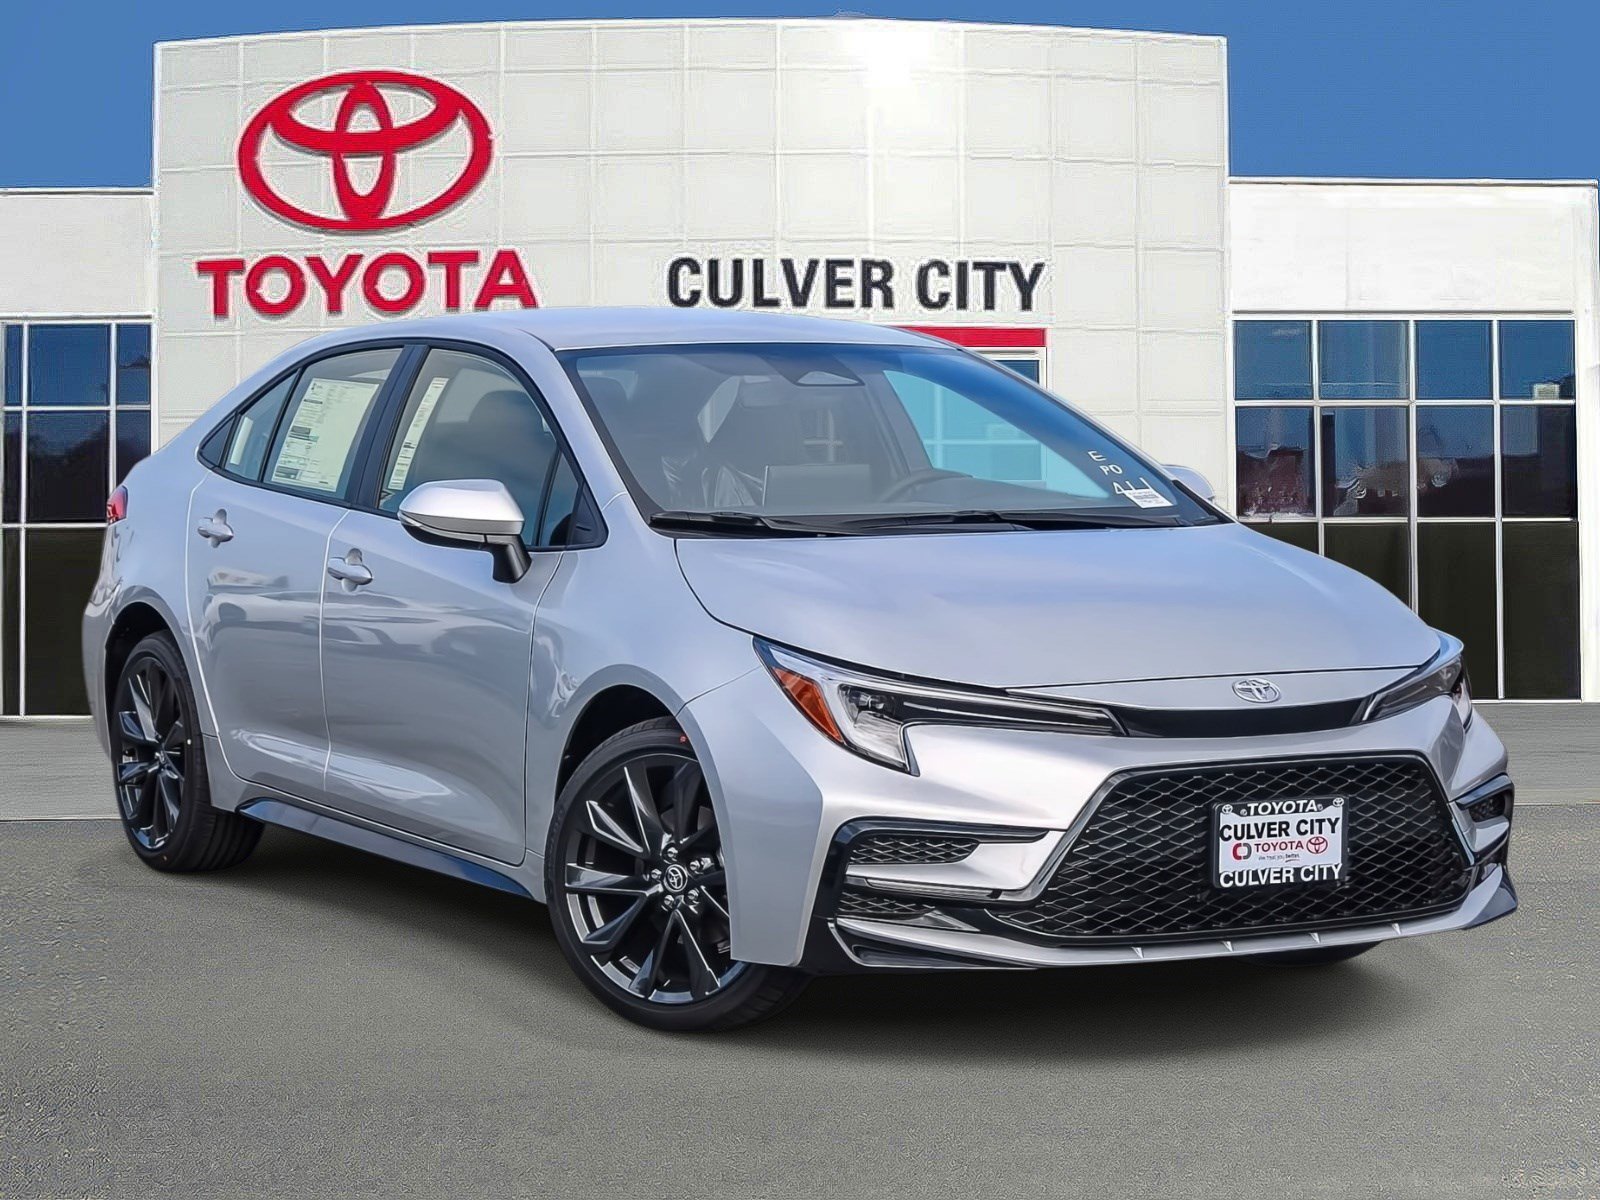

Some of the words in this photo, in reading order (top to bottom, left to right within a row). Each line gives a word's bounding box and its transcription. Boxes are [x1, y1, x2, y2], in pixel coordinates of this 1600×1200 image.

[196, 249, 539, 318] TOYOTA
[667, 257, 895, 308] CULVER
[916, 258, 1046, 311] CITY
[1247, 799, 1318, 816] TOYOTA
[1219, 821, 1290, 842] CULVER
[1296, 817, 1341, 836] CITY
[1254, 840, 1304, 853] TOYOTA
[1219, 867, 1295, 888] CULVER
[1300, 863, 1343, 882] CITY
